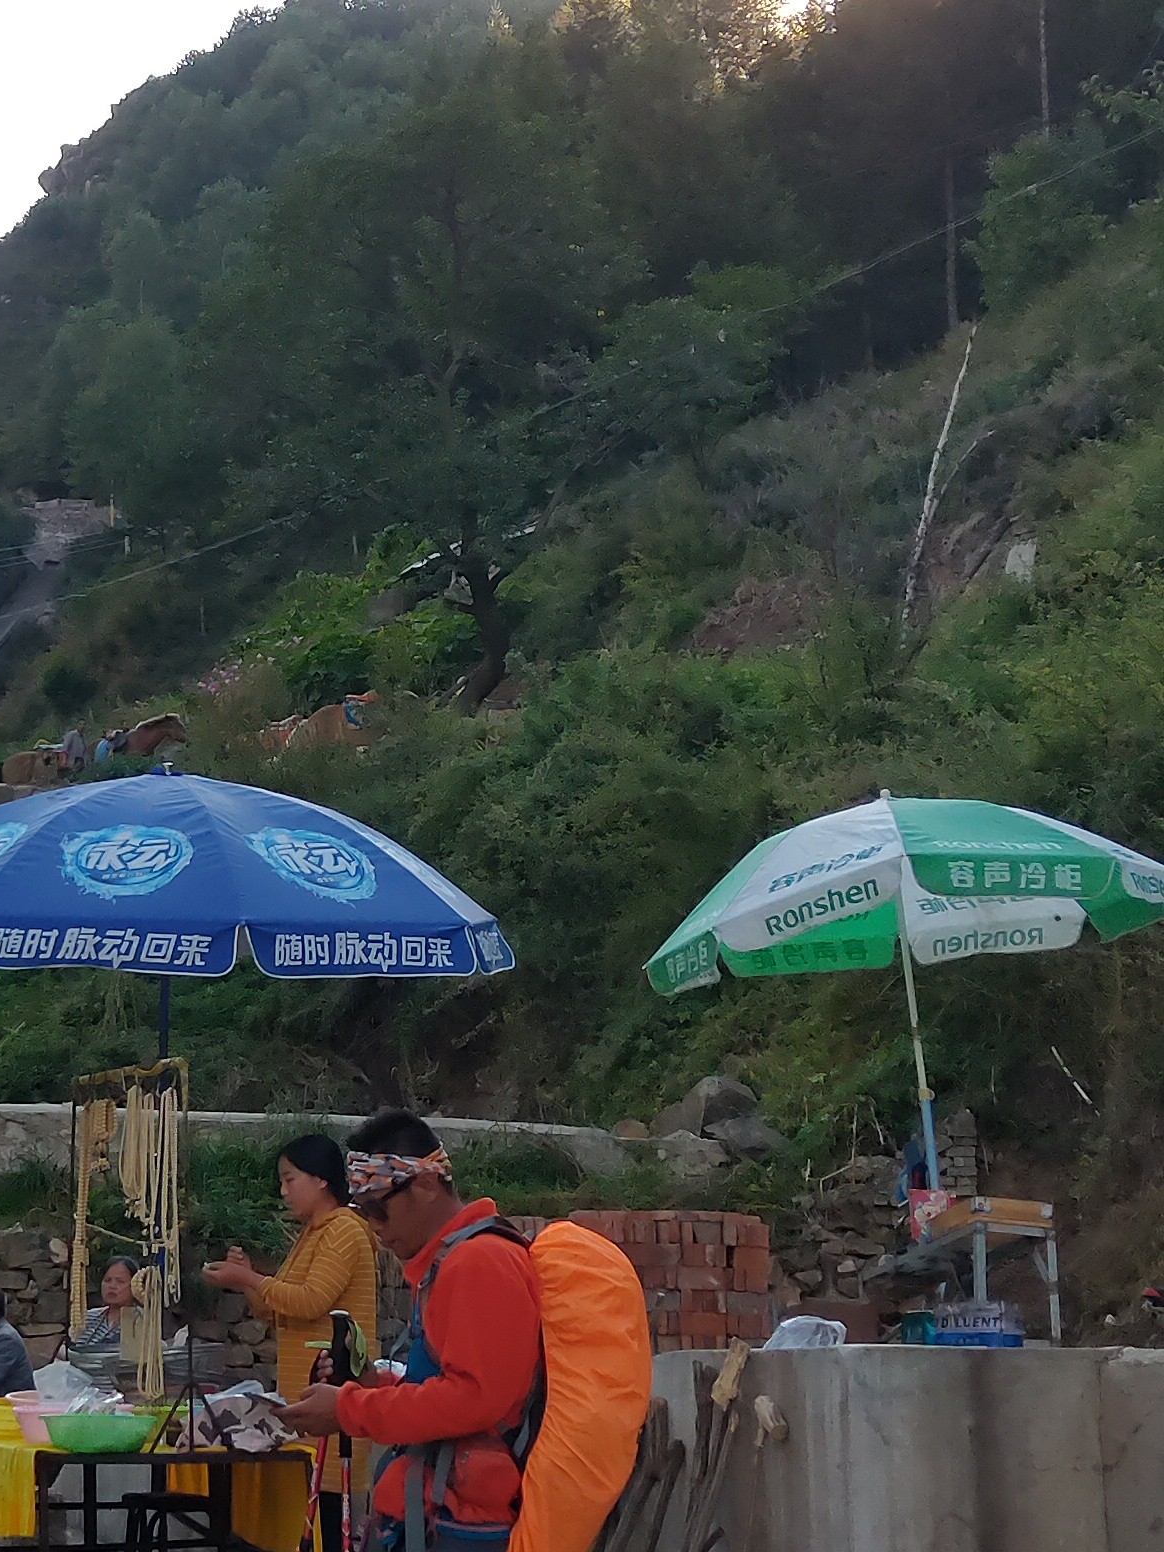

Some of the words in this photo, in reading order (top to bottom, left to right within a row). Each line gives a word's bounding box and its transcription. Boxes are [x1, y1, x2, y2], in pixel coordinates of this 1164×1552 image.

[947, 860, 1083, 891] 容声冷柜
[764, 878, 880, 936] Ronshen
[274, 932, 455, 973] 随时脉动回来
